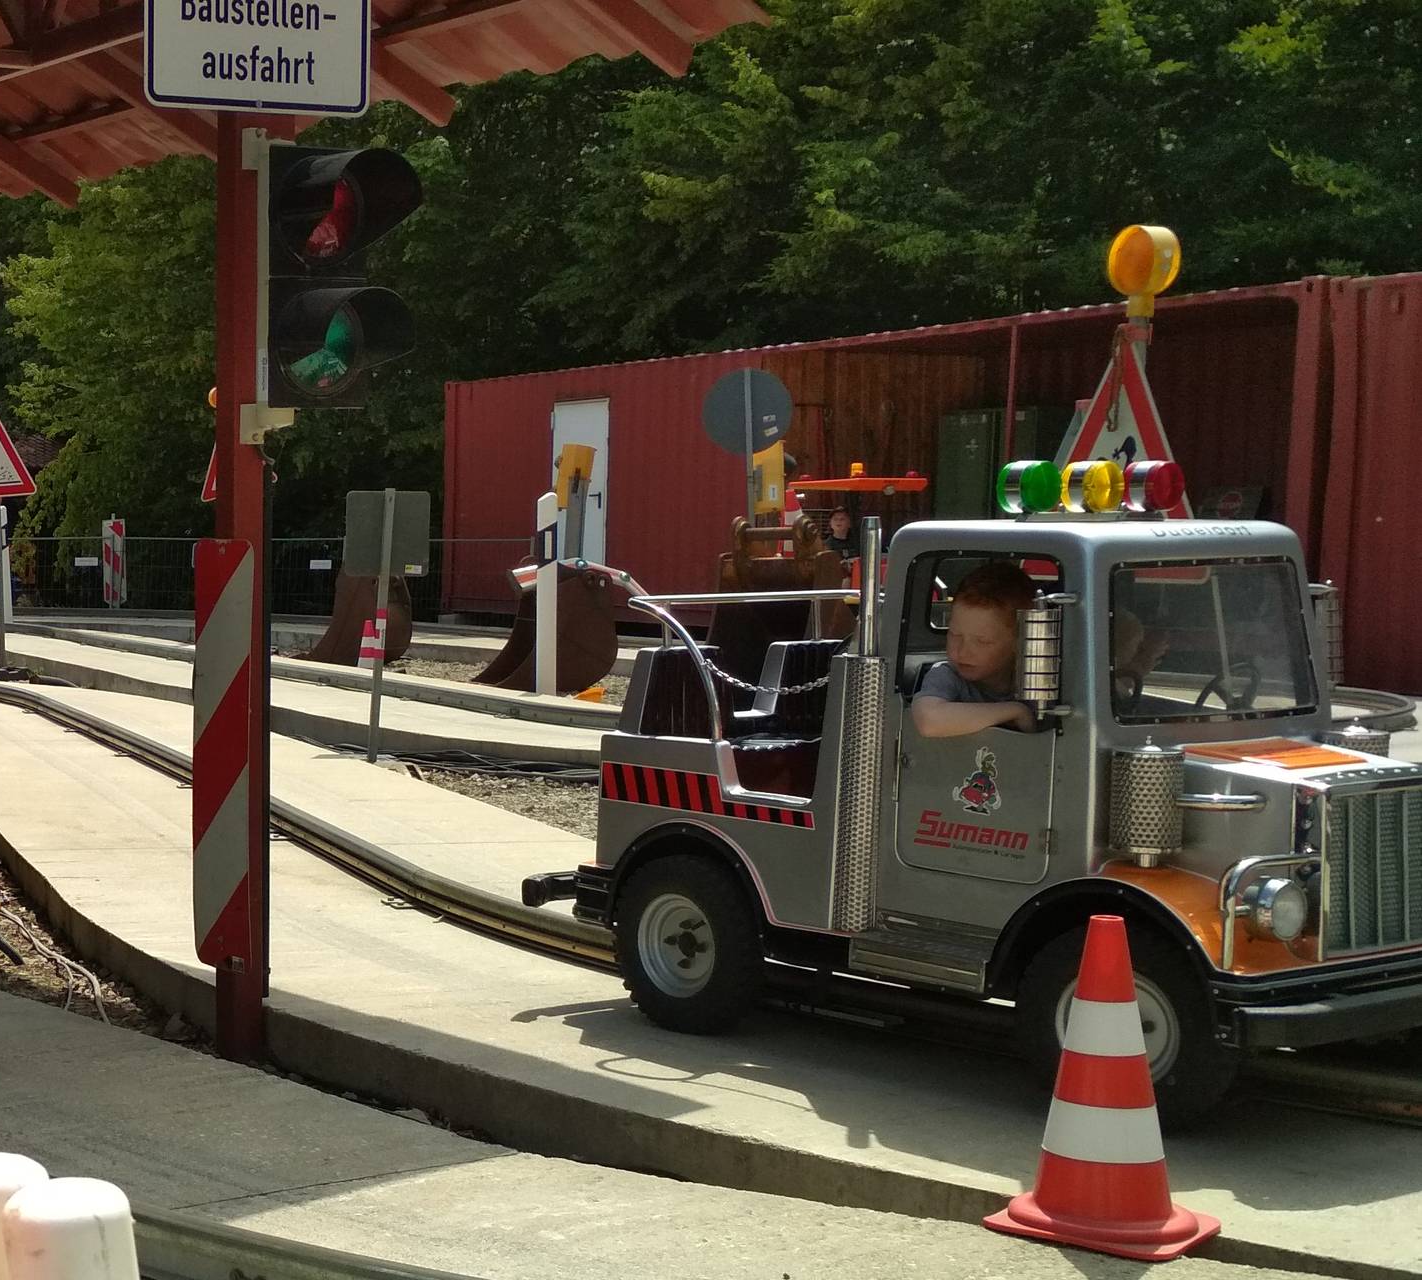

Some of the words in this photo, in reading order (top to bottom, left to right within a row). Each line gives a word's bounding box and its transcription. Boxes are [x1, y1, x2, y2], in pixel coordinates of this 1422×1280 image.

[181, 0, 337, 30] Baustellen-
[202, 45, 315, 85] ausfahrt
[916, 809, 1030, 850] Sumann
